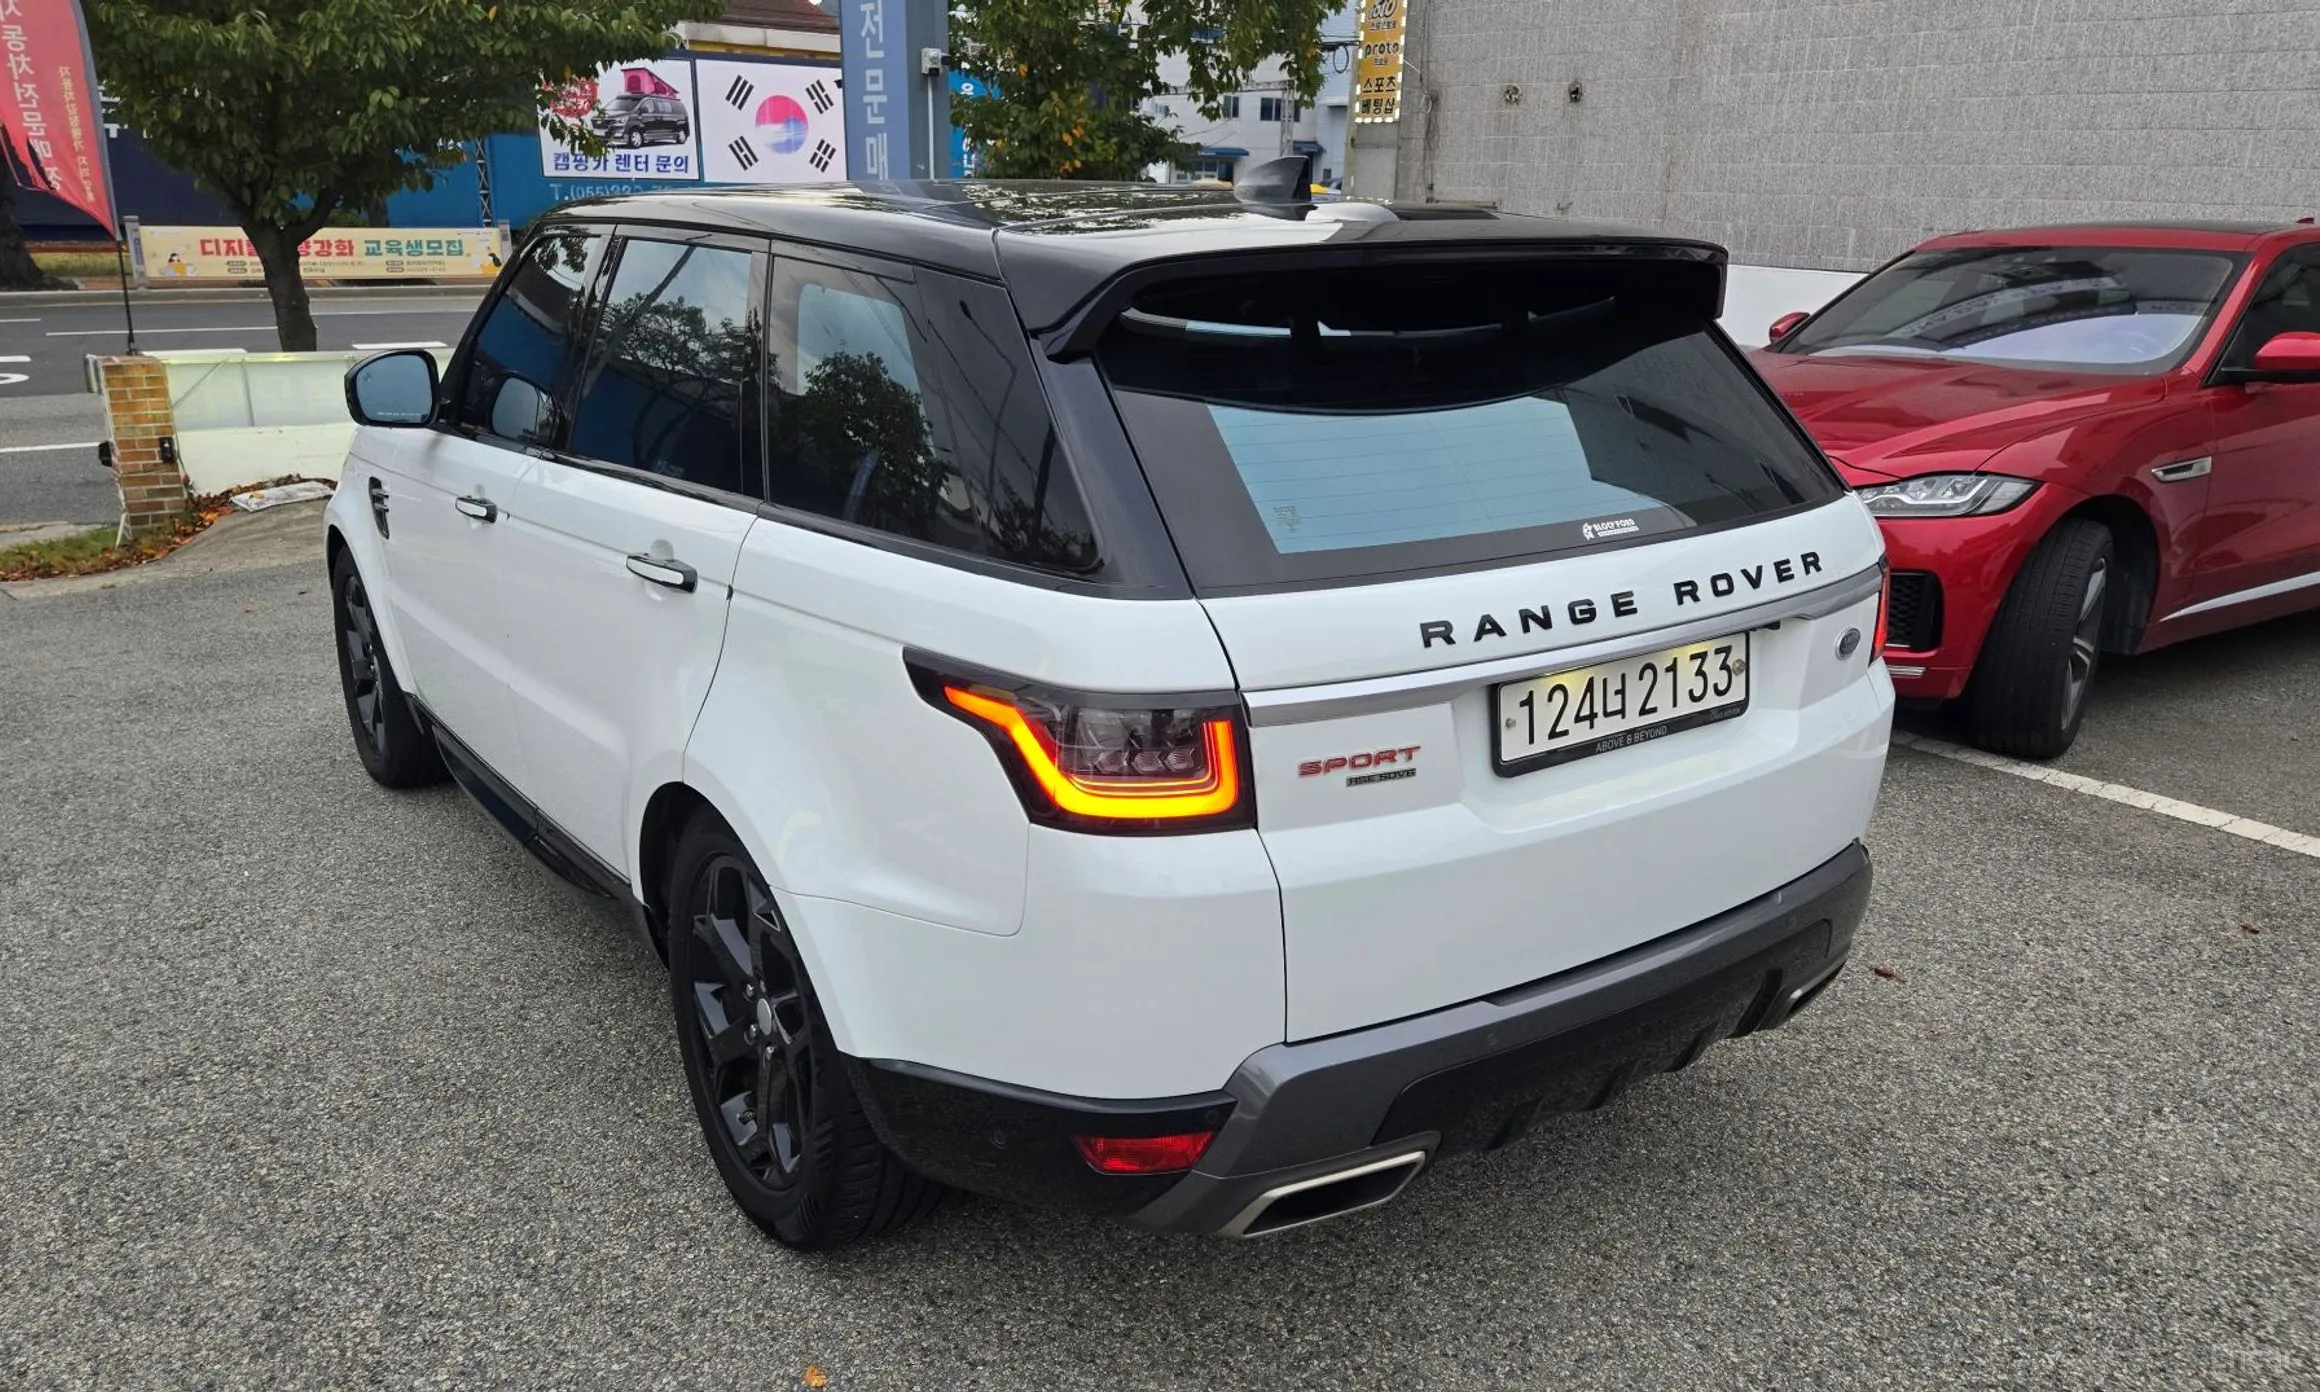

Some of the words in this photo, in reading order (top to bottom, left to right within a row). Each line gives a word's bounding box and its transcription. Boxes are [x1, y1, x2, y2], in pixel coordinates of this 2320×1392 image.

[1364, 42, 1400, 59] proto
[1362, 76, 1396, 93] 스포츠
[1361, 98, 1396, 115] 베팅샵
[553, 152, 609, 172] 캠핑카
[656, 155, 689, 174] 문의
[363, 238, 465, 257] 교육생모집
[1419, 591, 1640, 648] RANGE
[1673, 551, 1824, 607] ROVER
[1519, 672, 1627, 745] 124너
[1637, 645, 1734, 717] 2133
[1595, 735, 1625, 753] ABOVE
[1634, 725, 1668, 743] BEYOND
[1298, 745, 1421, 777] SPORT
